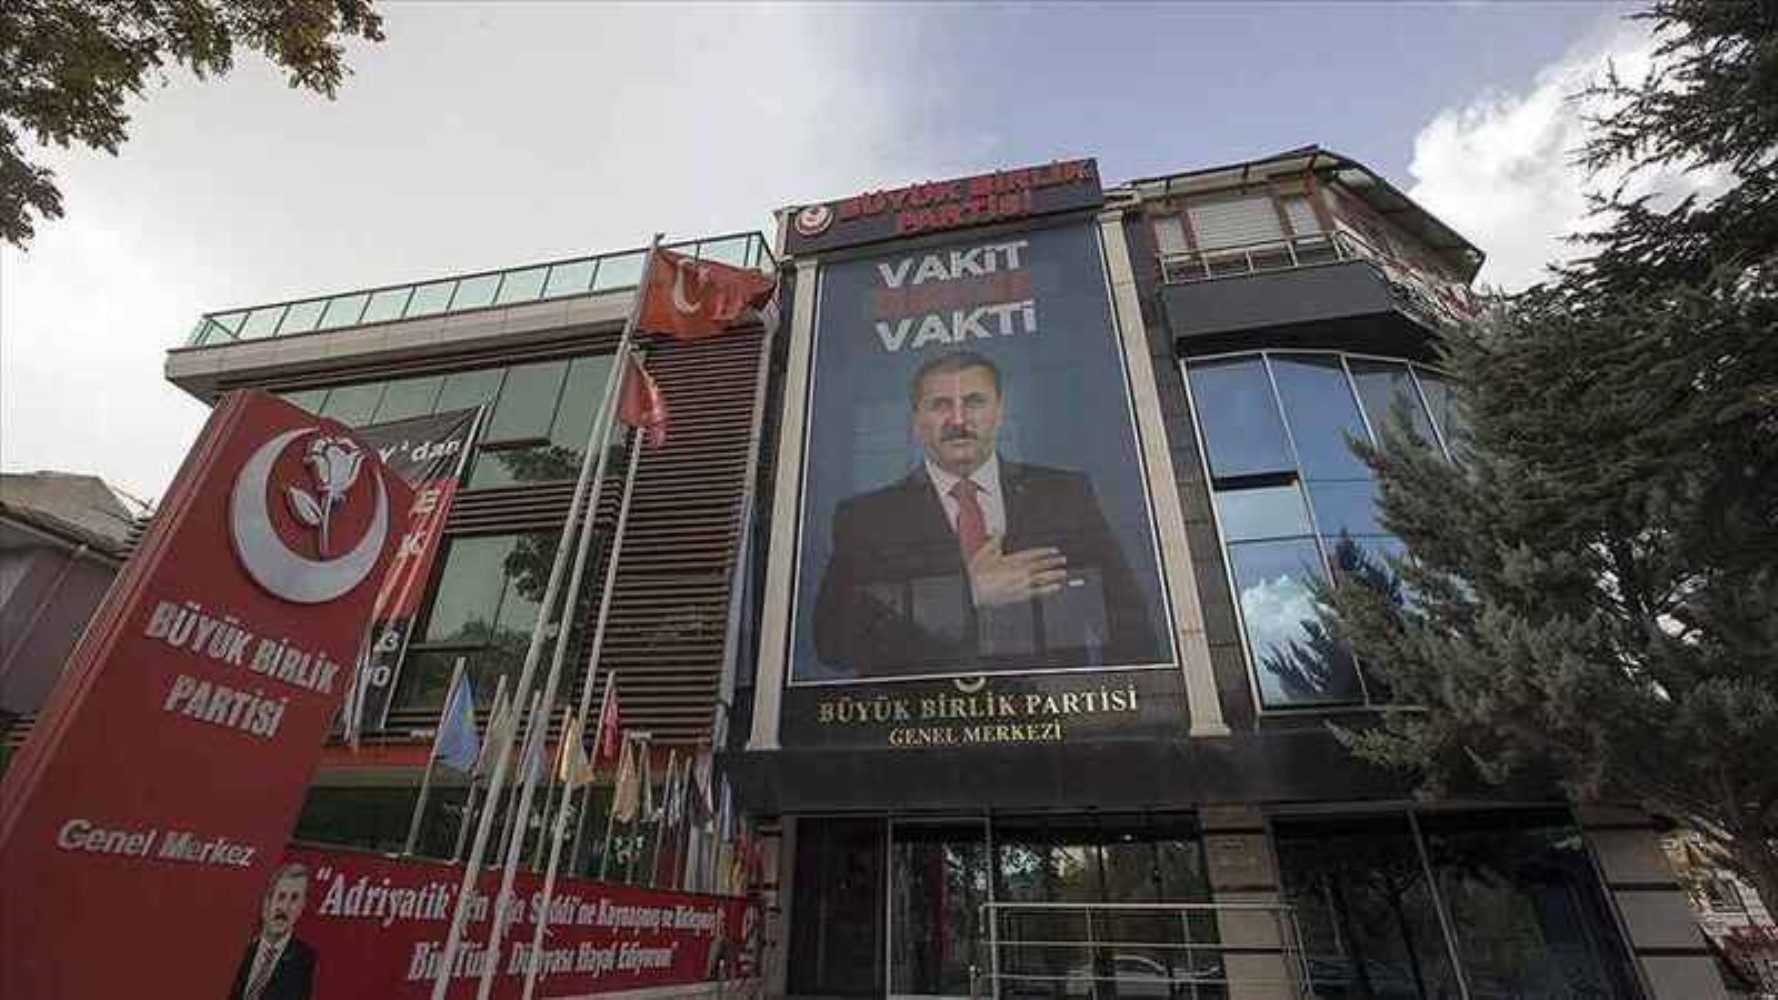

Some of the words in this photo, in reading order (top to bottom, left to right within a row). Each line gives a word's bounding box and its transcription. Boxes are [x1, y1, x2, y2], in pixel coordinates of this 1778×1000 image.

[144, 600, 254, 667] BÜYÜK
[249, 638, 341, 695] BİRLİK
[163, 673, 290, 739] PARTİSİ
[818, 695, 912, 723] BÜYÜK
[921, 690, 1018, 720] BİRLİK
[1025, 683, 1138, 716] PARTİSİ
[888, 726, 962, 748] GENEL
[962, 719, 1063, 746] MERKEZİ
[57, 818, 157, 858] Genel
[159, 831, 256, 868] Merkez
